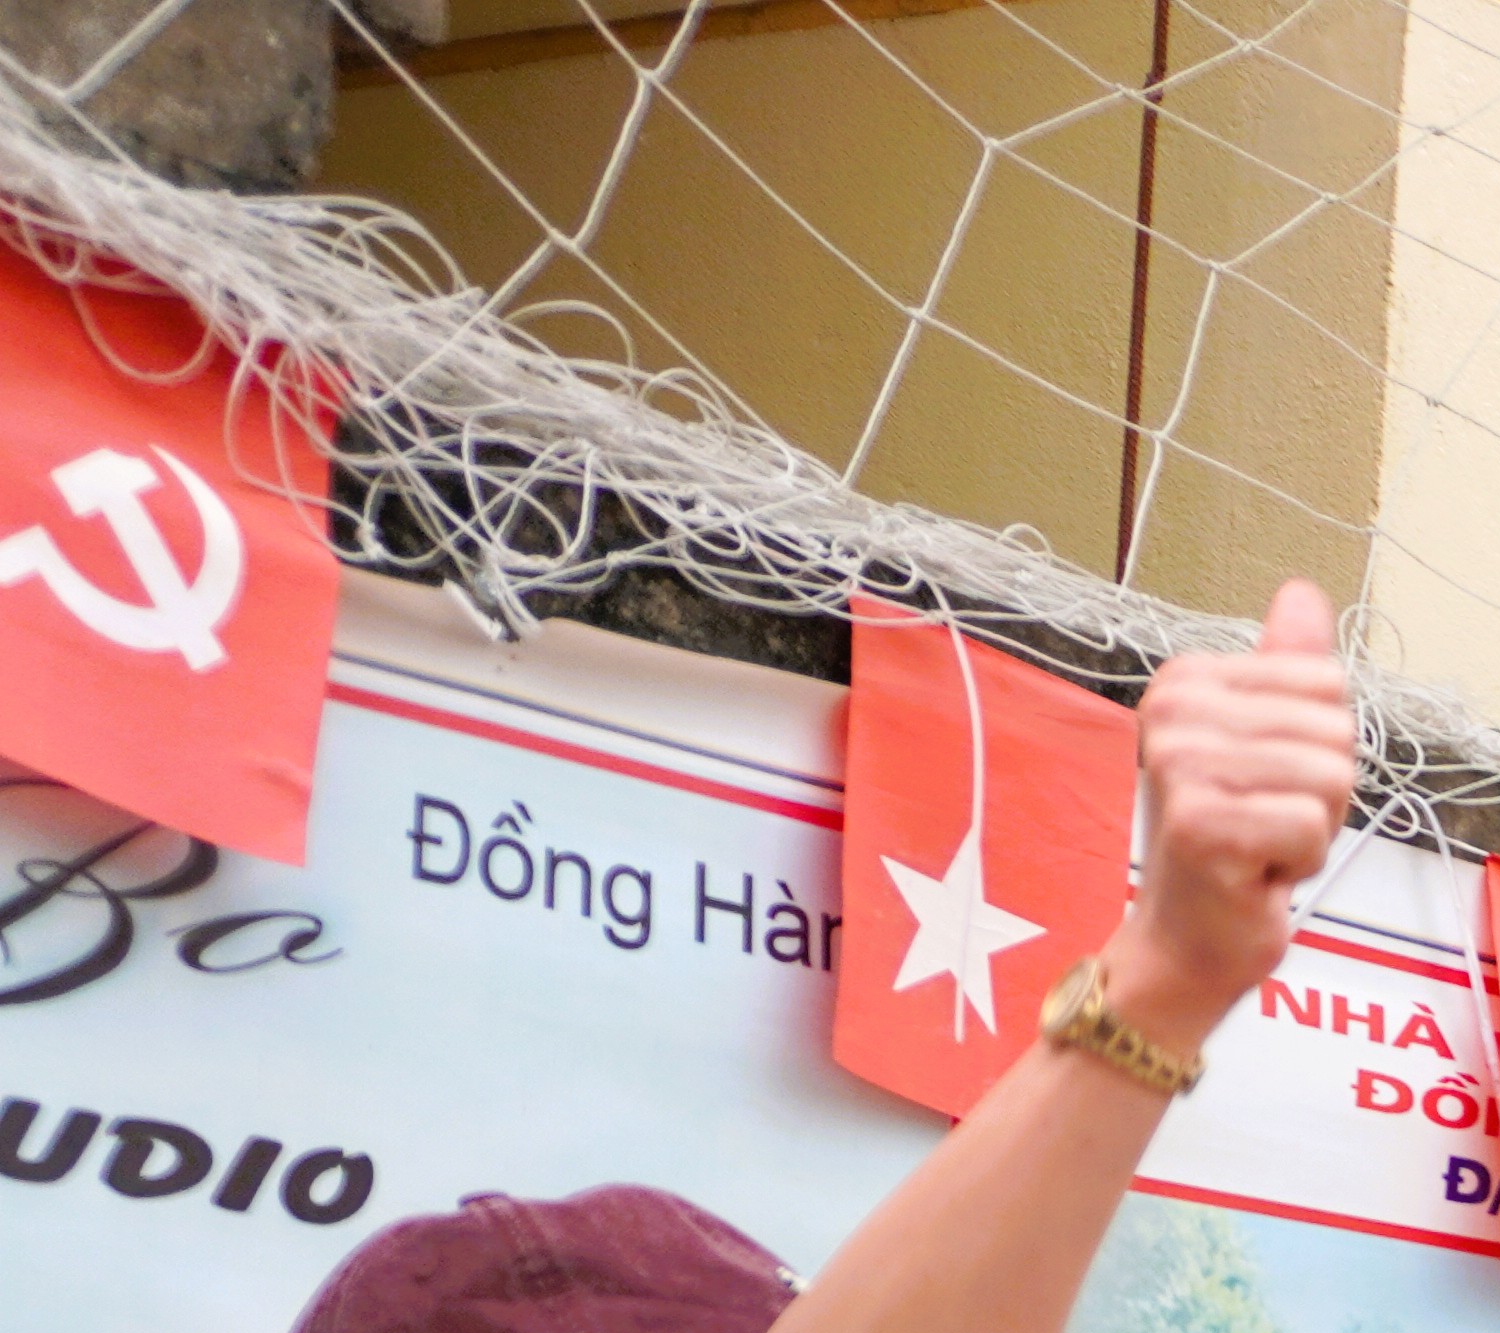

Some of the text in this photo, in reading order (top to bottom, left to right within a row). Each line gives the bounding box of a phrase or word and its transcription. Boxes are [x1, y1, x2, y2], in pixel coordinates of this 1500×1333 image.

[406, 792, 652, 950] Đồng
[1259, 976, 1456, 1062] NHÀ
[1350, 1068, 1500, 1138] ĐỒ
